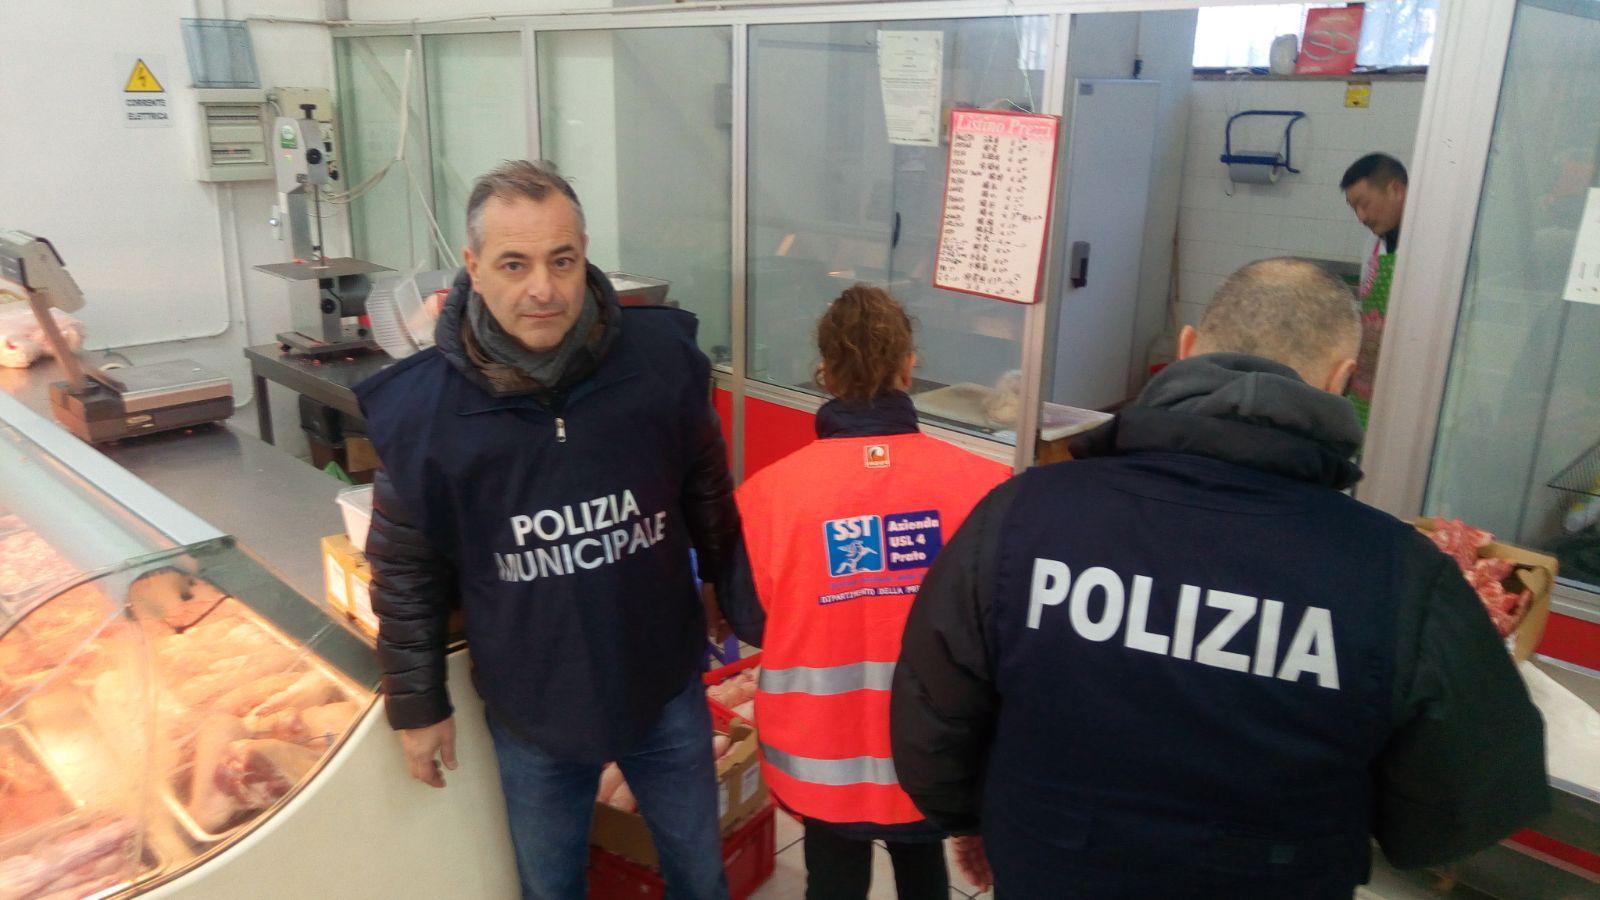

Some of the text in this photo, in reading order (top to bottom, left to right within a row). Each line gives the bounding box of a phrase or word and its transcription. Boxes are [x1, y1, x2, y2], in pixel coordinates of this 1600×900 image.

[126, 98, 167, 106] CORRENTE
[127, 112, 168, 120] ELETTRICA
[957, 115, 1005, 133] Listino
[510, 489, 641, 546] POLIZIA
[887, 516, 940, 532] Azienda
[832, 516, 874, 541] SST
[494, 510, 667, 582] MUNICIPALE
[889, 533, 926, 548] USL 4
[890, 550, 926, 563] Prato
[820, 587, 876, 604] DIPARTIMENTO
[878, 586, 904, 595] DELLA
[1026, 557, 1340, 690] POLIZIA
